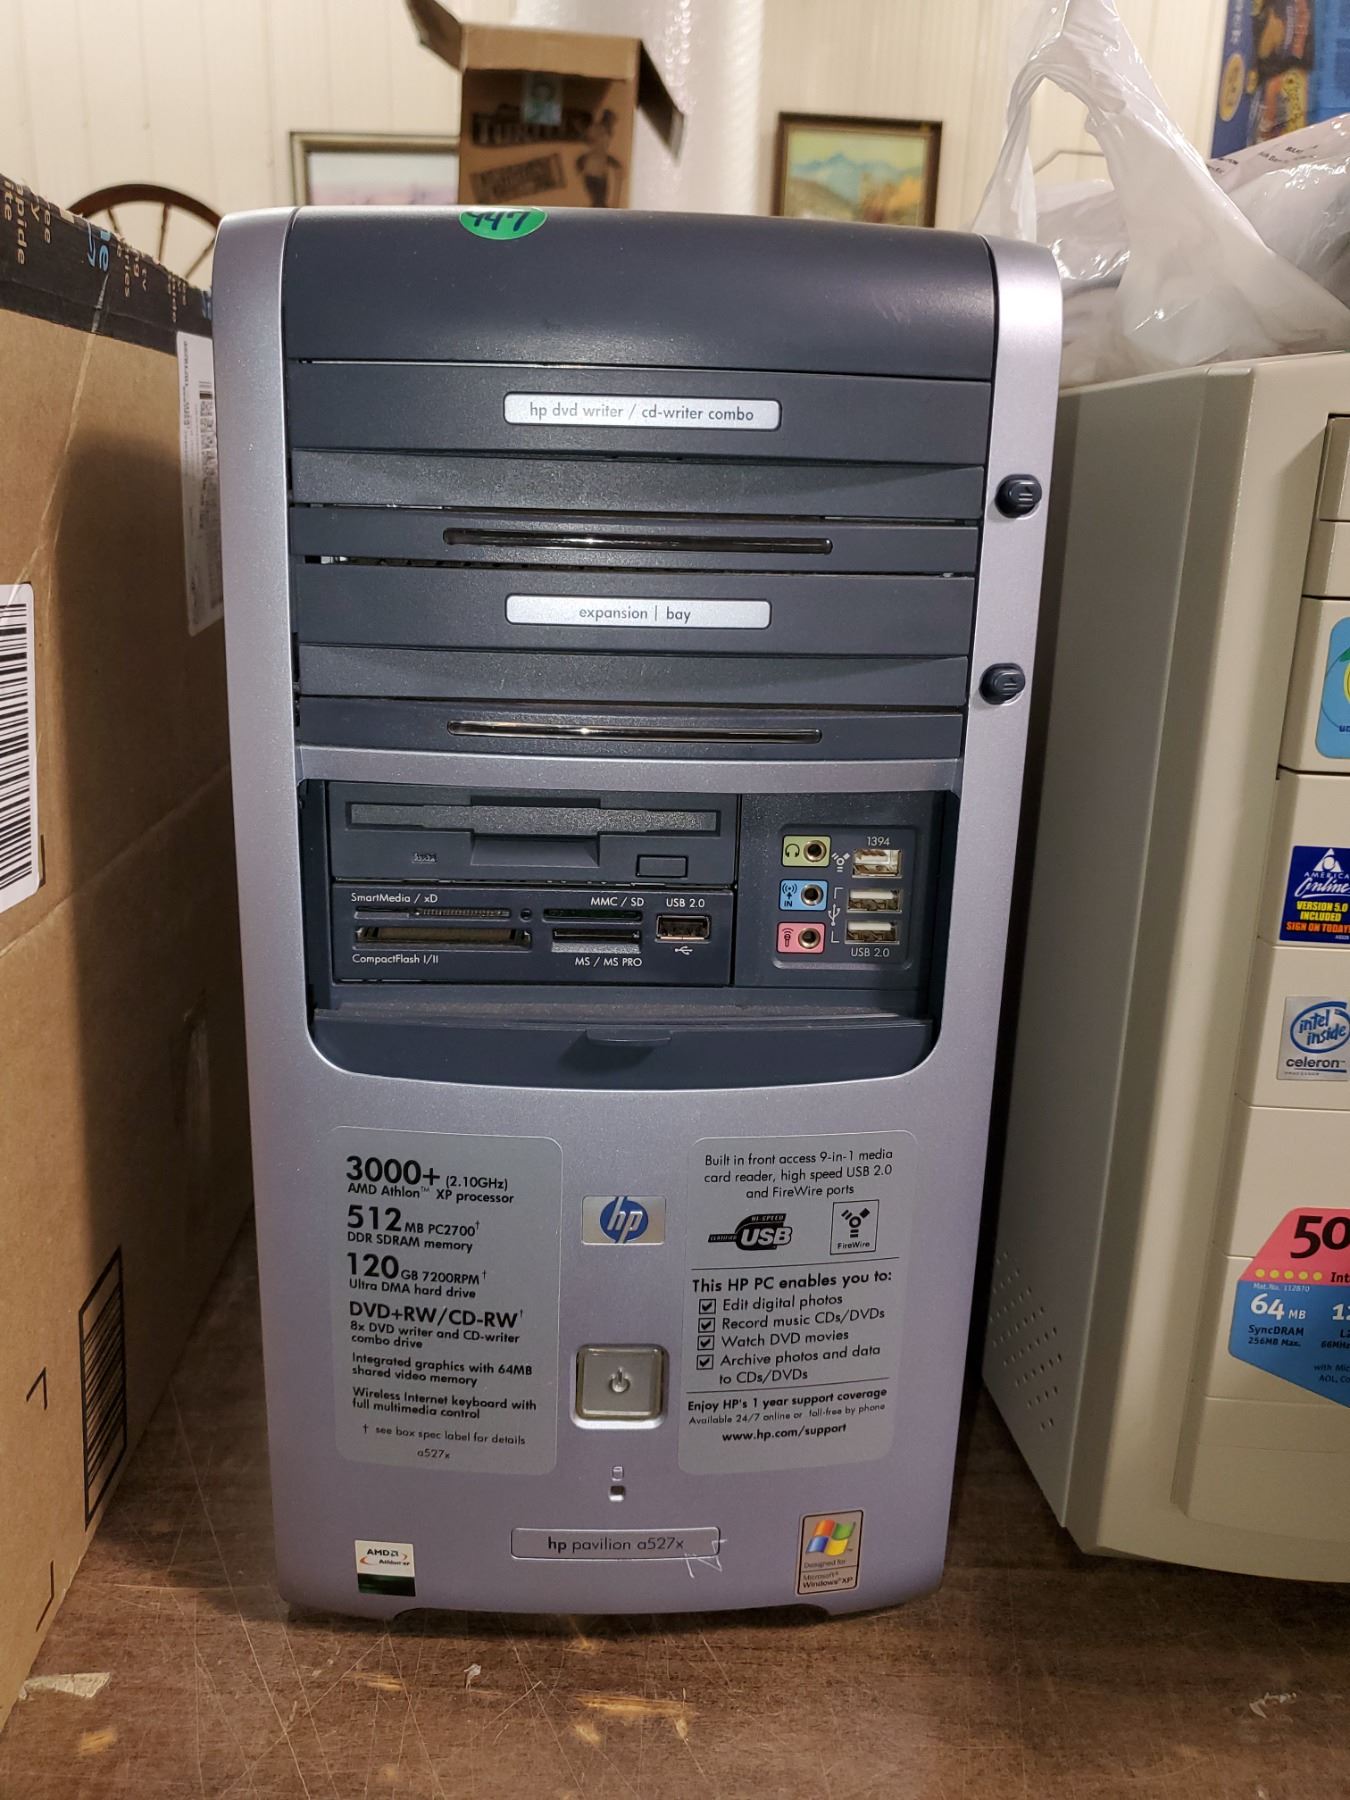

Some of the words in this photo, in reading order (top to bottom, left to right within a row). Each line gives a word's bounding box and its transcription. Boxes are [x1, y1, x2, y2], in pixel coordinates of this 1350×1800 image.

[529, 402, 548, 420] hp
[552, 402, 578, 417] dvd
[583, 404, 624, 418] writer
[642, 405, 703, 420] cd-writer
[708, 407, 754, 421] combo
[579, 607, 648, 622] expansion
[666, 606, 691, 623] bay
[867, 836, 890, 846] 1394
[1304, 871, 1350, 879] AMERICA
[351, 892, 411, 903] SmartMedia
[424, 894, 438, 903] xD
[590, 897, 618, 906] MMC
[630, 897, 645, 906] SD
[666, 899, 685, 908] USB
[689, 899, 705, 908] 2.0
[1296, 901, 1333, 911] VERSION
[1334, 903, 1348, 912] 5.0
[1300, 911, 1342, 922] INCLUDED
[1286, 921, 1307, 931] SIGN
[1308, 922, 1320, 932] ON
[352, 954, 420, 965] CompactFlash
[574, 957, 590, 966] MS
[603, 957, 618, 966] MS
[622, 958, 642, 967] PRO
[851, 947, 870, 957] USB
[874, 948, 890, 958] 2.0
[1299, 1009, 1330, 1033] intel
[1306, 1023, 1346, 1045] inside
[705, 1154, 731, 1166] Built
[733, 1154, 744, 1166] in
[748, 1153, 776, 1165] front
[779, 1154, 816, 1165] access
[820, 1150, 853, 1162] 9-in-1
[858, 1147, 893, 1161] media
[346, 1155, 440, 1186] 3000+
[446, 1175, 508, 1191] (2.10GHz)
[704, 1171, 731, 1183] card
[735, 1170, 776, 1184] reader,
[781, 1169, 806, 1183] high
[809, 1167, 843, 1182] speed
[847, 1165, 870, 1178] USB
[873, 1164, 893, 1177] 2.0
[347, 1182, 377, 1195] AMD
[436, 1188, 452, 1200] XP
[456, 1191, 514, 1204] processor
[746, 1187, 768, 1199] and
[773, 1185, 823, 1198] FireWire
[826, 1184, 855, 1198] ports
[347, 1204, 402, 1232] 512
[404, 1222, 424, 1234] MB
[603, 1195, 645, 1244] hp
[347, 1231, 372, 1243] DDR
[376, 1233, 420, 1248] SDRAM
[424, 1240, 473, 1254] memory
[740, 1226, 792, 1246] USB
[837, 1240, 871, 1250] FireWire
[347, 1252, 399, 1279] 120
[401, 1269, 418, 1281] GB
[349, 1279, 378, 1291] Ultra
[381, 1281, 410, 1294] DMA
[414, 1285, 443, 1297] hard
[446, 1286, 476, 1299] drive
[692, 1278, 722, 1293] This
[728, 1278, 749, 1292] HP
[754, 1276, 775, 1290] PC
[779, 1273, 837, 1290] enables
[842, 1275, 869, 1288] you
[874, 1271, 892, 1283] to:
[723, 1297, 748, 1311] Edit
[753, 1295, 795, 1312] digital
[800, 1293, 843, 1310] photos
[1250, 1293, 1285, 1320] 64
[1288, 1309, 1306, 1319] MB
[722, 1315, 768, 1330] Record
[773, 1314, 810, 1327] music
[815, 1307, 885, 1324] CDs/DVDs
[350, 1320, 365, 1331] 8x
[369, 1322, 394, 1334] DVD
[398, 1326, 433, 1338] writer
[436, 1328, 459, 1339] and
[463, 1330, 520, 1344] CD-writer
[722, 1333, 765, 1347] Watch
[770, 1332, 800, 1346] DVD
[805, 1329, 849, 1343] movies
[1248, 1324, 1304, 1336] SyncDRAM
[351, 1334, 390, 1346] combo
[394, 1336, 423, 1349] drive
[1247, 1336, 1279, 1346] 256MB
[352, 1352, 411, 1368] Integrated
[415, 1358, 465, 1373] graphics
[469, 1363, 494, 1374] with
[498, 1363, 533, 1376] 64MB
[720, 1352, 771, 1367] Archive
[775, 1350, 818, 1367] photos
[822, 1346, 847, 1360] and
[852, 1344, 880, 1357] data
[352, 1366, 391, 1378] shared
[395, 1370, 426, 1382] video
[430, 1374, 478, 1387] memory
[719, 1373, 731, 1384] to
[736, 1368, 808, 1384] CDs/DVDs
[352, 1387, 400, 1401] Wireless
[404, 1392, 448, 1405] Internet
[452, 1395, 507, 1410] keyboard
[512, 1399, 537, 1411] with
[687, 1399, 719, 1412] Enjoy
[723, 1398, 748, 1410] HP's
[752, 1397, 758, 1408] 1
[762, 1397, 788, 1410] year
[791, 1393, 834, 1408] support
[837, 1388, 888, 1403] coverage
[352, 1399, 370, 1409] full
[373, 1401, 437, 1416] multimedia
[441, 1407, 480, 1419] control
[689, 1413, 733, 1424] Available
[735, 1413, 760, 1424] 24/7
[763, 1411, 791, 1421] online
[793, 1411, 803, 1419] or
[809, 1406, 842, 1418] toll-free
[845, 1405, 856, 1416] by
[858, 1403, 885, 1414] phone
[375, 1427, 392, 1436] see
[396, 1427, 415, 1437] box
[418, 1430, 441, 1440] spec
[445, 1431, 470, 1442] label
[473, 1432, 489, 1443] for
[492, 1434, 526, 1445] details
[722, 1423, 847, 1442] www.hp.com/support
[417, 1449, 450, 1460] a527x
[548, 1536, 567, 1554] hp
[572, 1535, 631, 1554] pavilion
[636, 1537, 684, 1550] a527x
